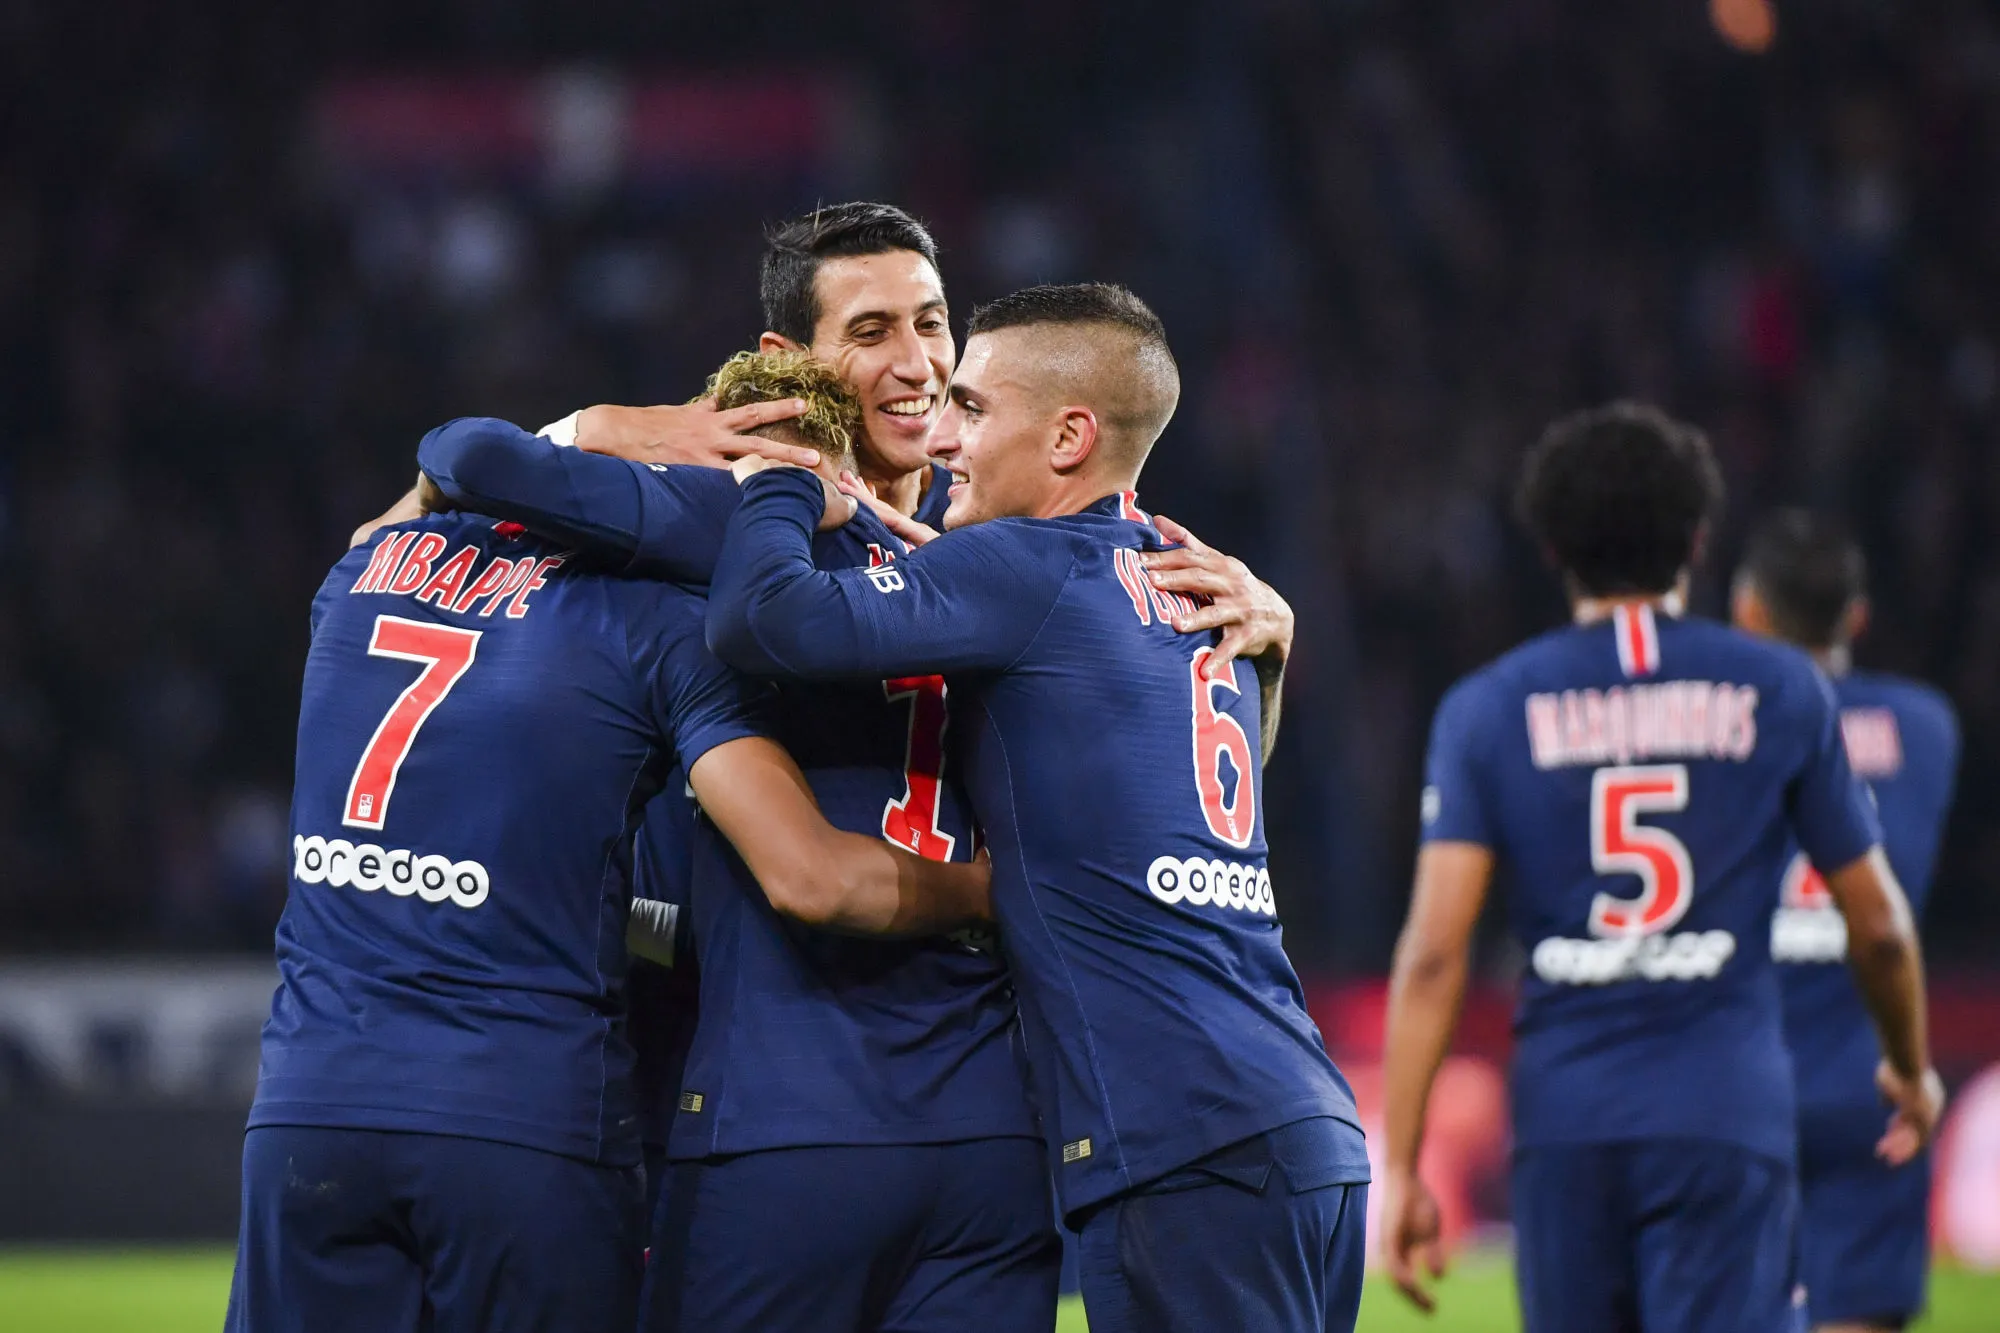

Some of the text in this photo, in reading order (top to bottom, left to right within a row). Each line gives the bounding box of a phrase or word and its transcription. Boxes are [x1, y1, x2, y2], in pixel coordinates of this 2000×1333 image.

[342, 615, 483, 831] 7
[881, 673, 976, 865] 1
[1189, 645, 1256, 849] 6
[295, 839, 485, 903] oredoo
[1151, 861, 1274, 910] ooredo
[1588, 765, 1694, 937] 5
